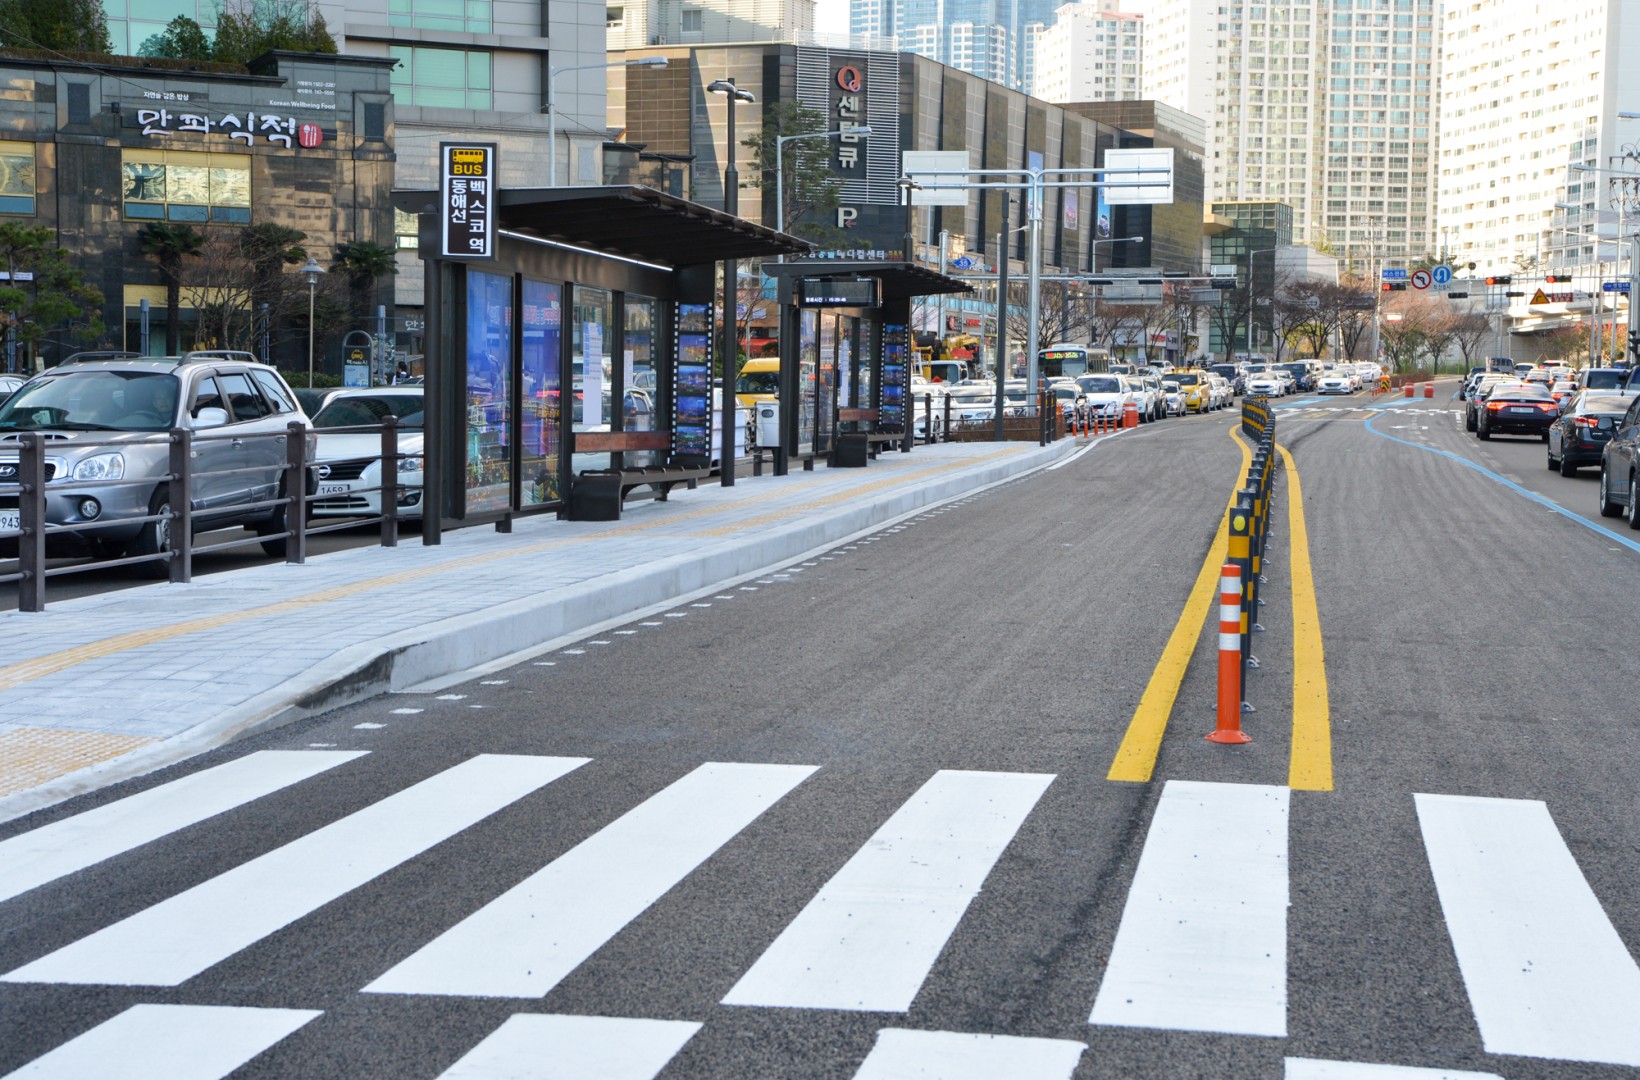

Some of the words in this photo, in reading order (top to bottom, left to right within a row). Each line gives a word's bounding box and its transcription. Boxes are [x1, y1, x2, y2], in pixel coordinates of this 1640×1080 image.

[290, 101, 320, 109] Wellbeing
[838, 96, 860, 168] 센텀큐
[453, 164, 483, 175] BUS
[451, 179, 467, 224] 동해선
[469, 180, 485, 253] 벡스코역
[838, 207, 857, 228] P
